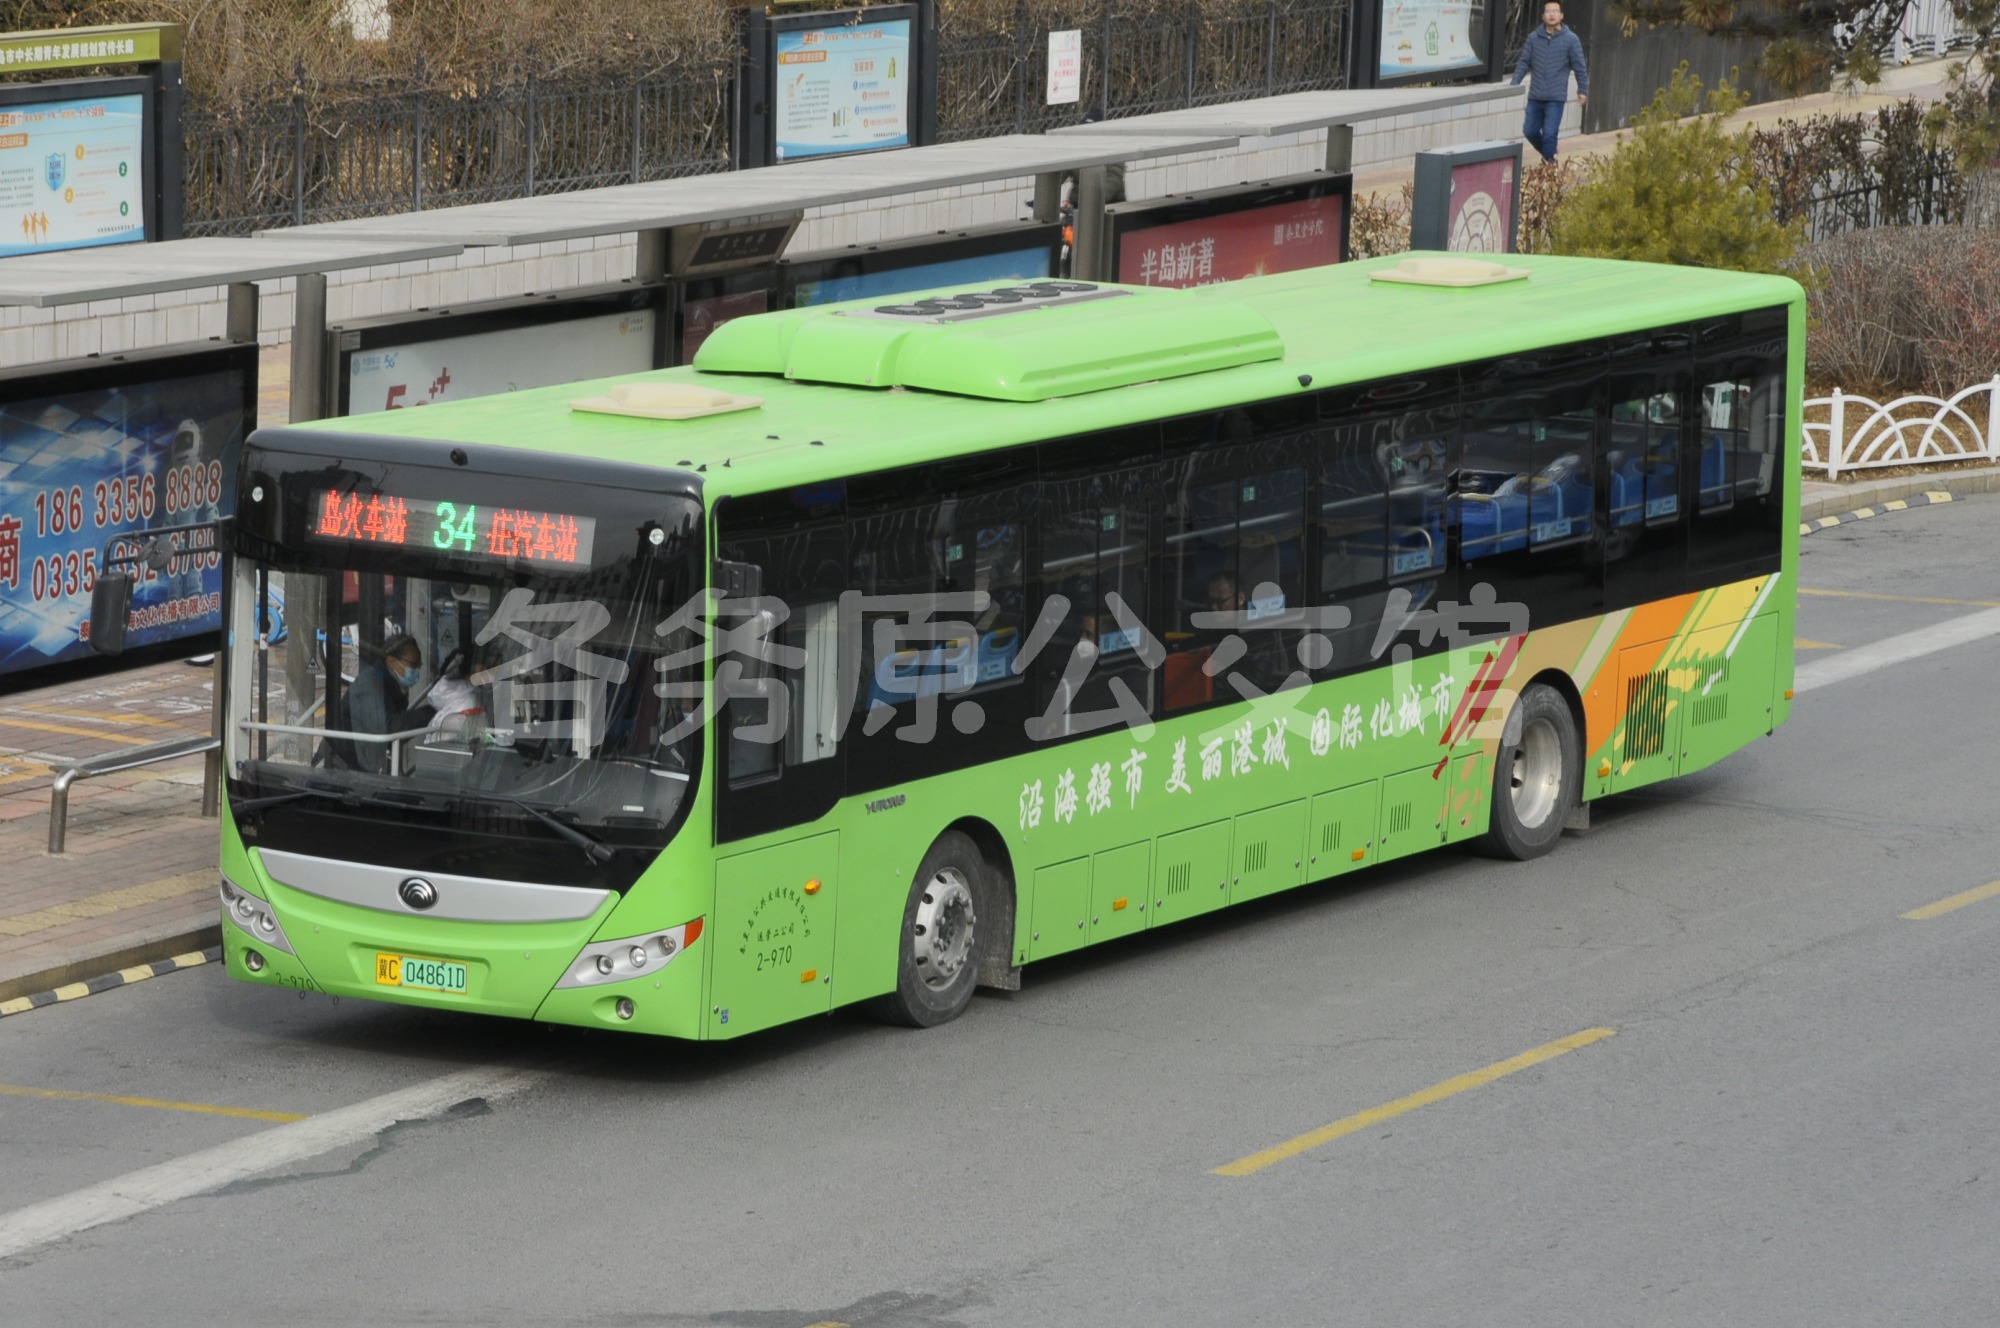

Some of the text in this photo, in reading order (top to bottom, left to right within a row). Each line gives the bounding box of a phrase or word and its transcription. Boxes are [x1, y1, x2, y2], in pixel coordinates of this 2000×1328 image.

[1140, 237, 1215, 286] 半岛新著
[34, 459, 222, 538] 186 3356 8888
[433, 501, 476, 552] 34
[486, 507, 578, 563] 庄汽车站
[1019, 672, 1455, 830] 沿海强市 美丽港城 国际化城市
[275, 971, 314, 991] 2-970
[757, 945, 792, 971] 2-970
